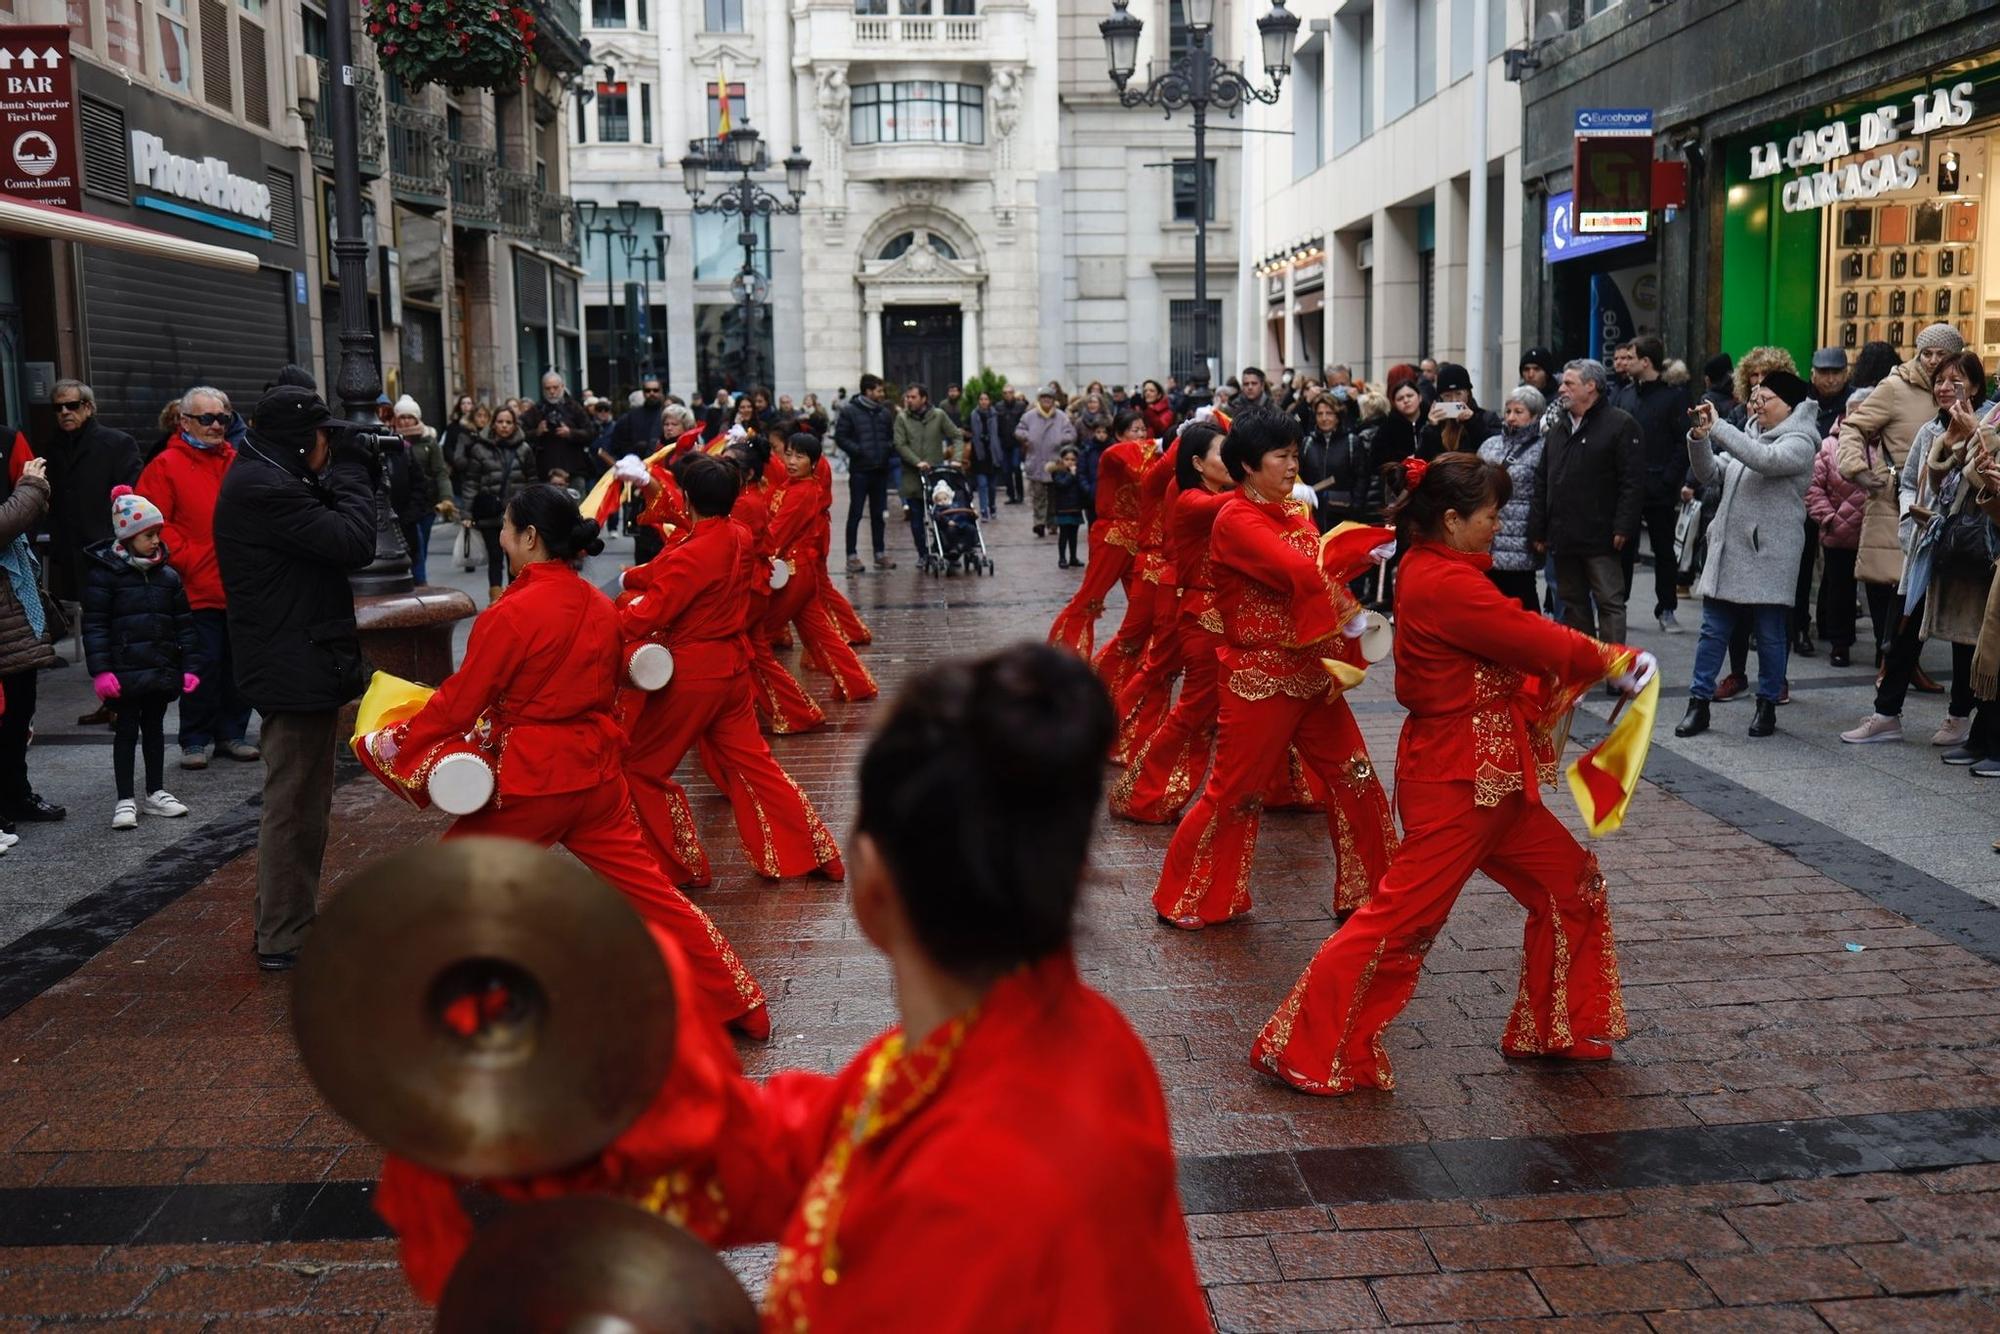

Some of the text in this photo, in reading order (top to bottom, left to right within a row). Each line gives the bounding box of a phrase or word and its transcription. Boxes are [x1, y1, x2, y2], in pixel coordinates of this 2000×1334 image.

[8, 77, 53, 94] BAR
[0, 100, 70, 111] lanta Superior
[7, 112, 57, 122] First Floor
[1749, 82, 1973, 180] LA CASA DE LAS
[1782, 149, 1920, 213] CARCASAS
